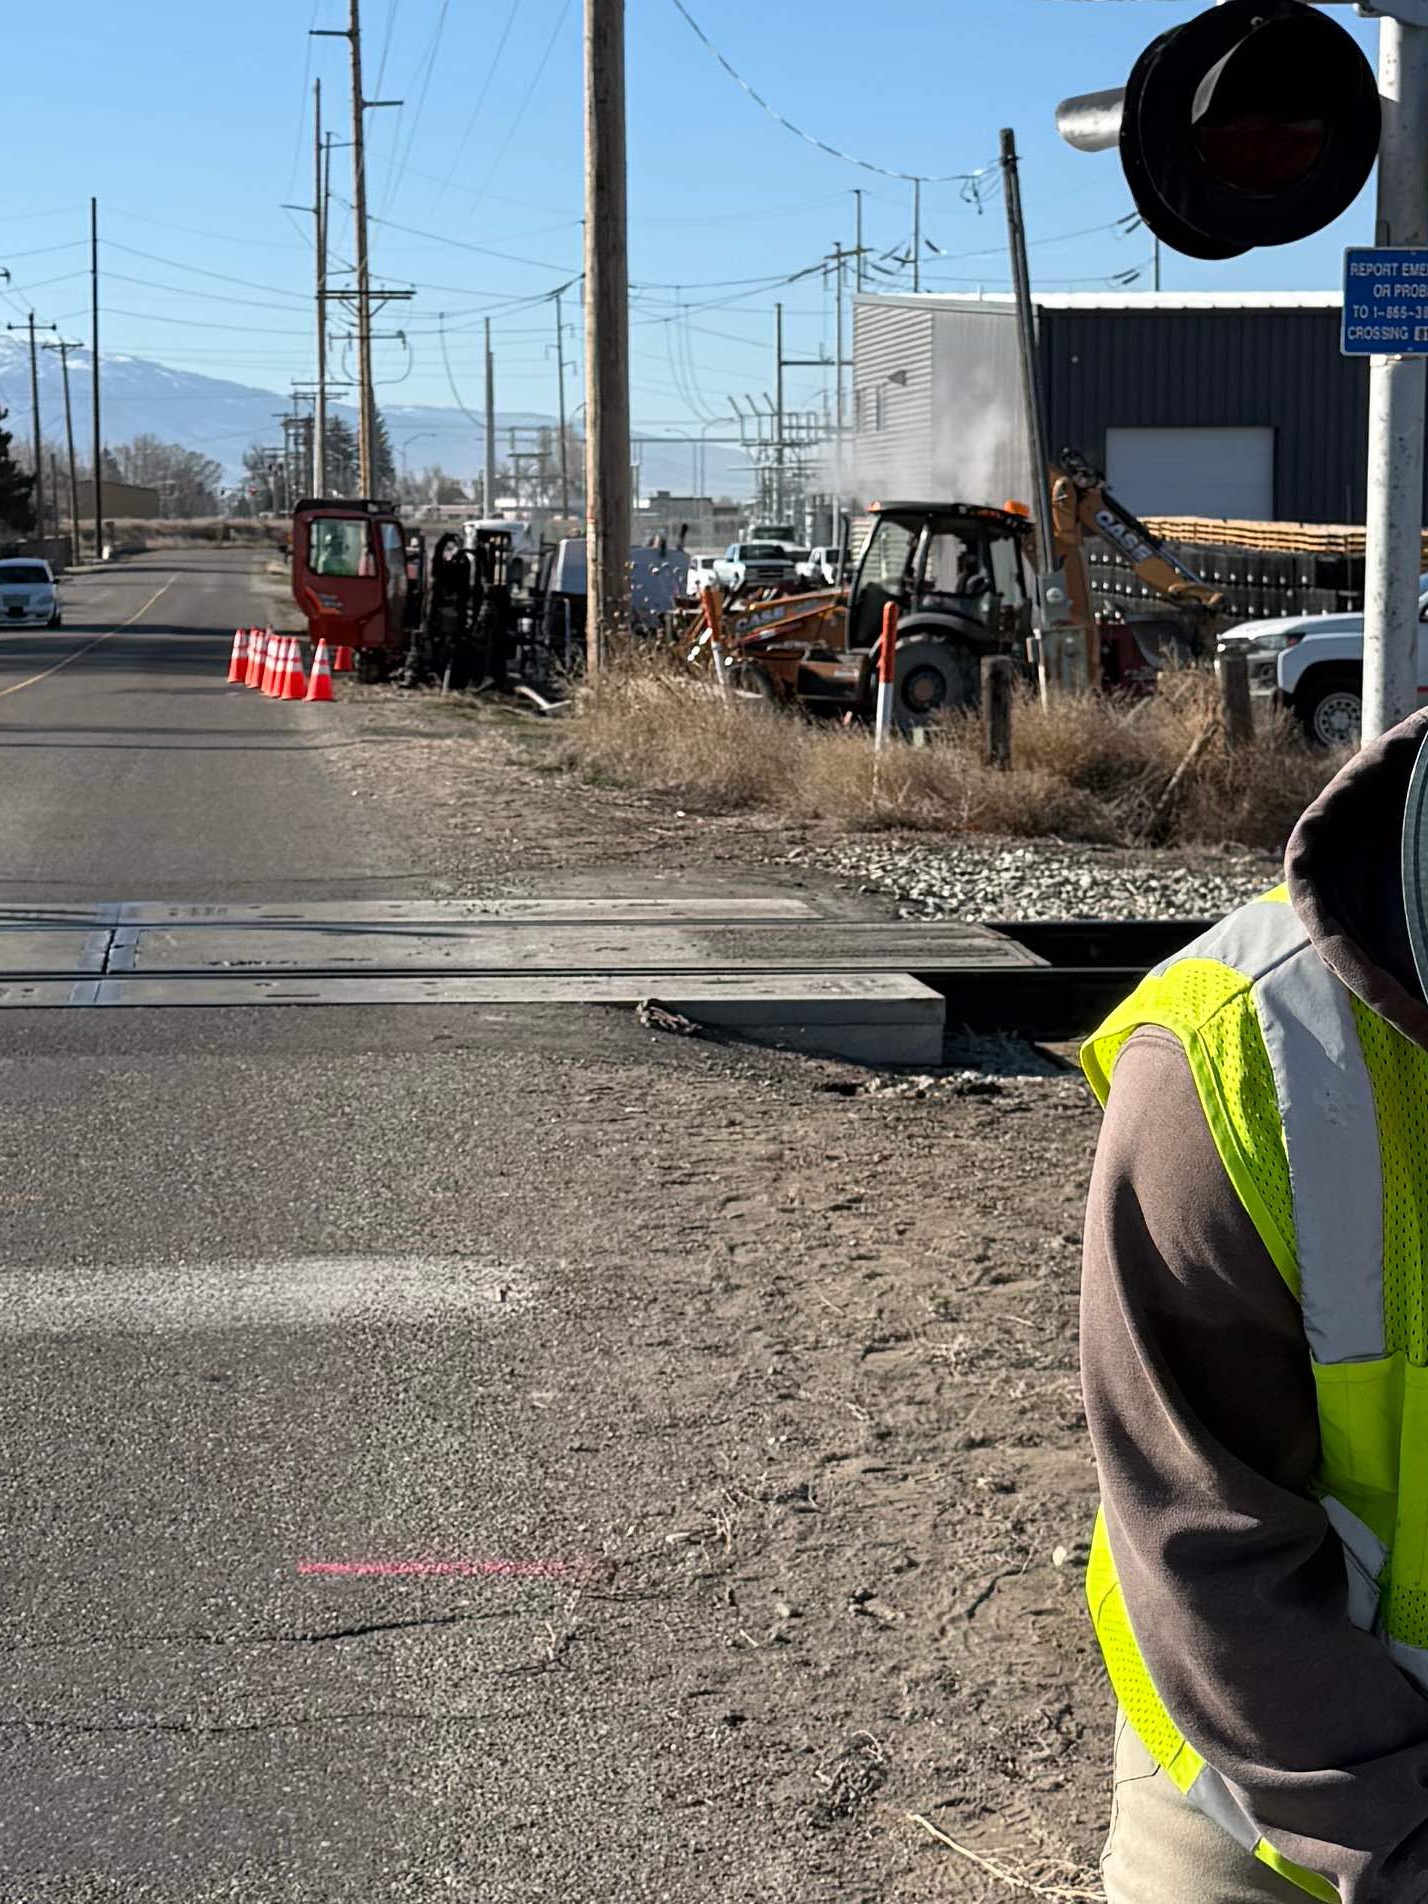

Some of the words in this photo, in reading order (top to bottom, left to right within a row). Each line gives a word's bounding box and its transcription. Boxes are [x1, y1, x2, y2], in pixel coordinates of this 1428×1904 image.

[1350, 262, 1398, 277] REPORT
[1373, 283, 1391, 298] OR
[1352, 304, 1369, 319] TO
[1347, 325, 1409, 341] CROSSING
